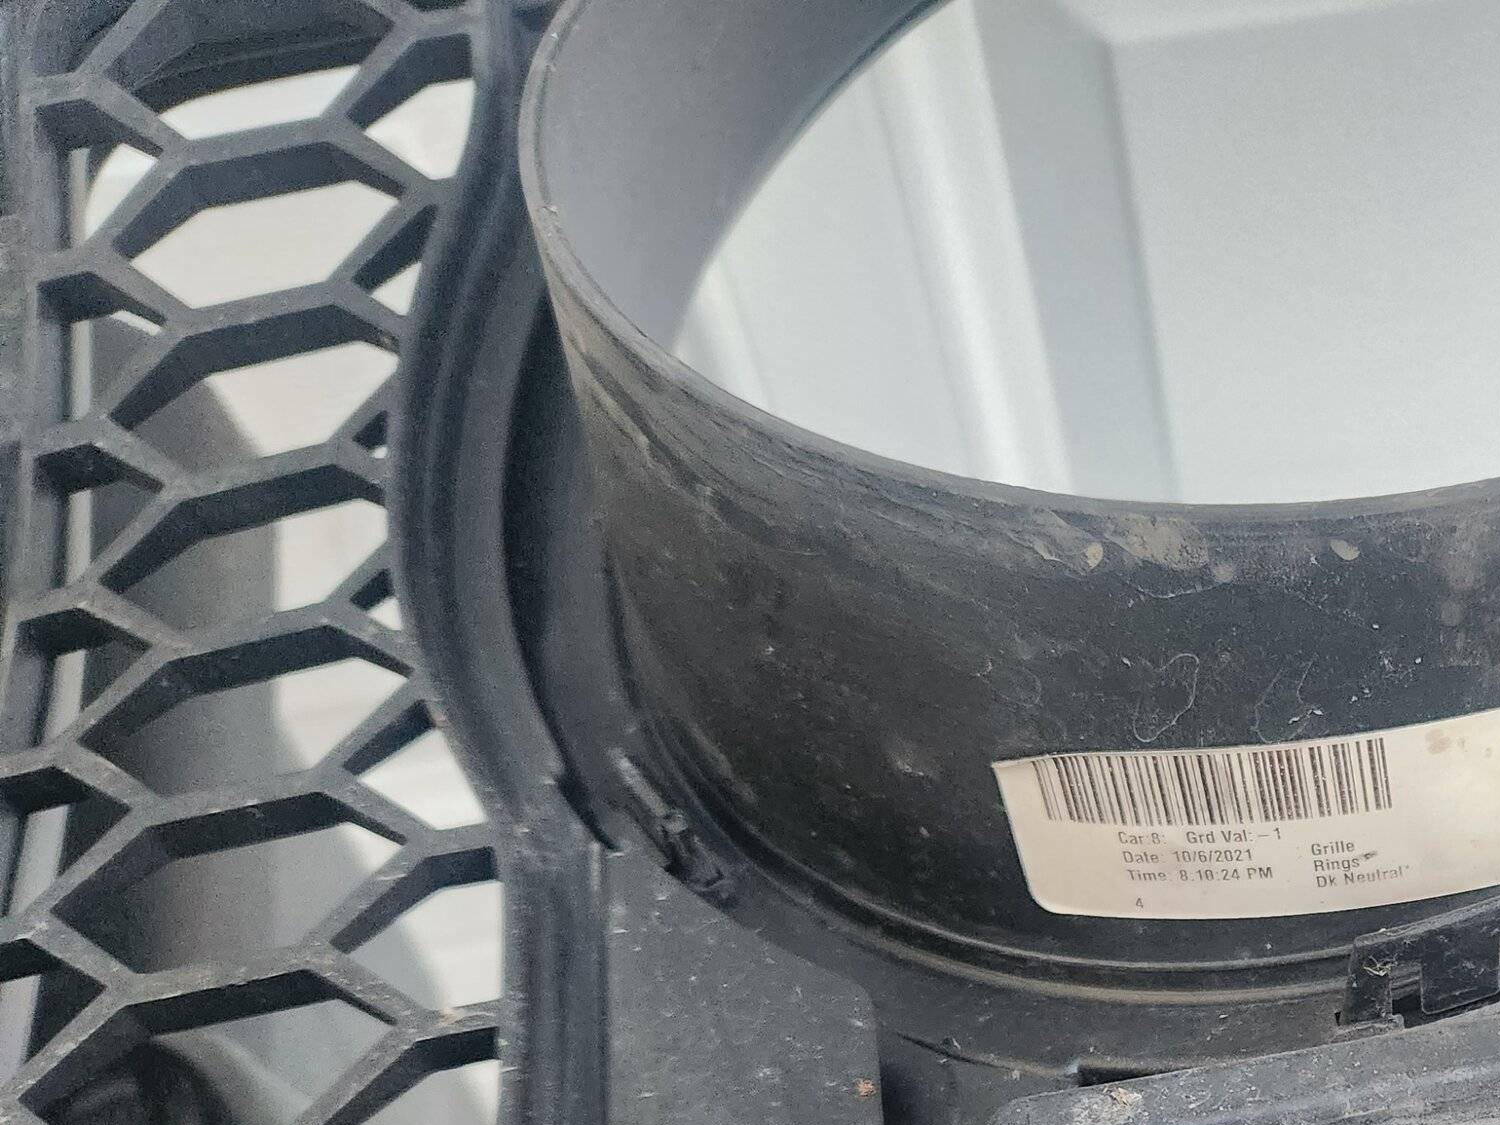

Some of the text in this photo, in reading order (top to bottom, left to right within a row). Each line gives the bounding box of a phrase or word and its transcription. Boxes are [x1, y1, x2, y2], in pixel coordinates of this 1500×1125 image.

[1186, 831, 1216, 844] Grd
[1311, 841, 1355, 856] Grille
[1172, 849, 1252, 863] 10/6/2021
[1314, 857, 1360, 872] Rings
[1247, 866, 1273, 880] PM
[1316, 874, 1337, 888] Dk
